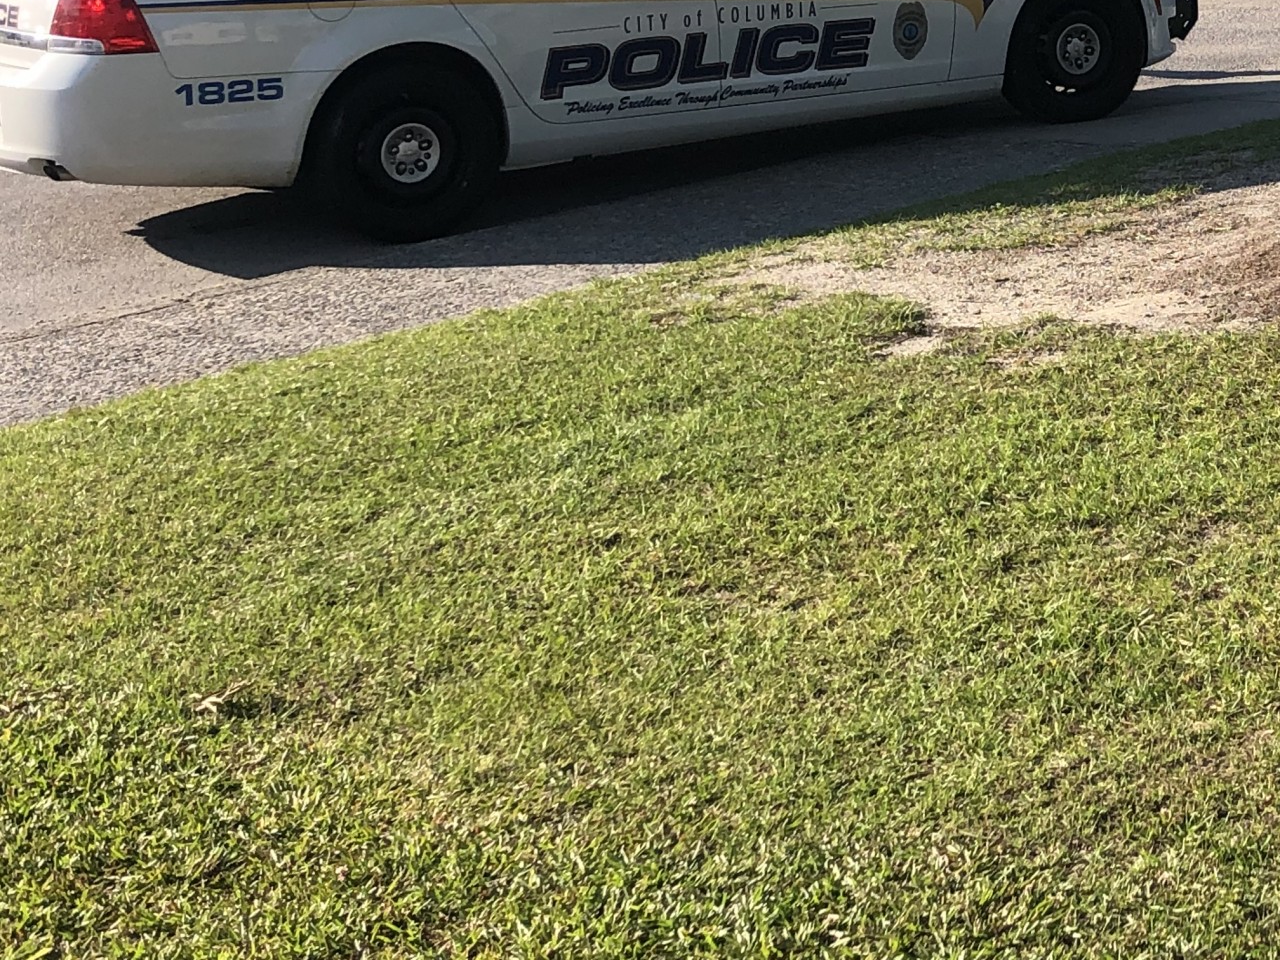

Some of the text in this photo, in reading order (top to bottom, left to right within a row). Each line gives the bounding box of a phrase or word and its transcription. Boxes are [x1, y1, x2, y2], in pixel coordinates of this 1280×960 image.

[623, 1, 817, 33] CITY of COLUMBIA
[540, 17, 876, 101] POLICE
[175, 77, 284, 106] 1825
[617, 96, 673, 111] Excellence
[675, 91, 718, 107] Through
[720, 83, 780, 102] Community
